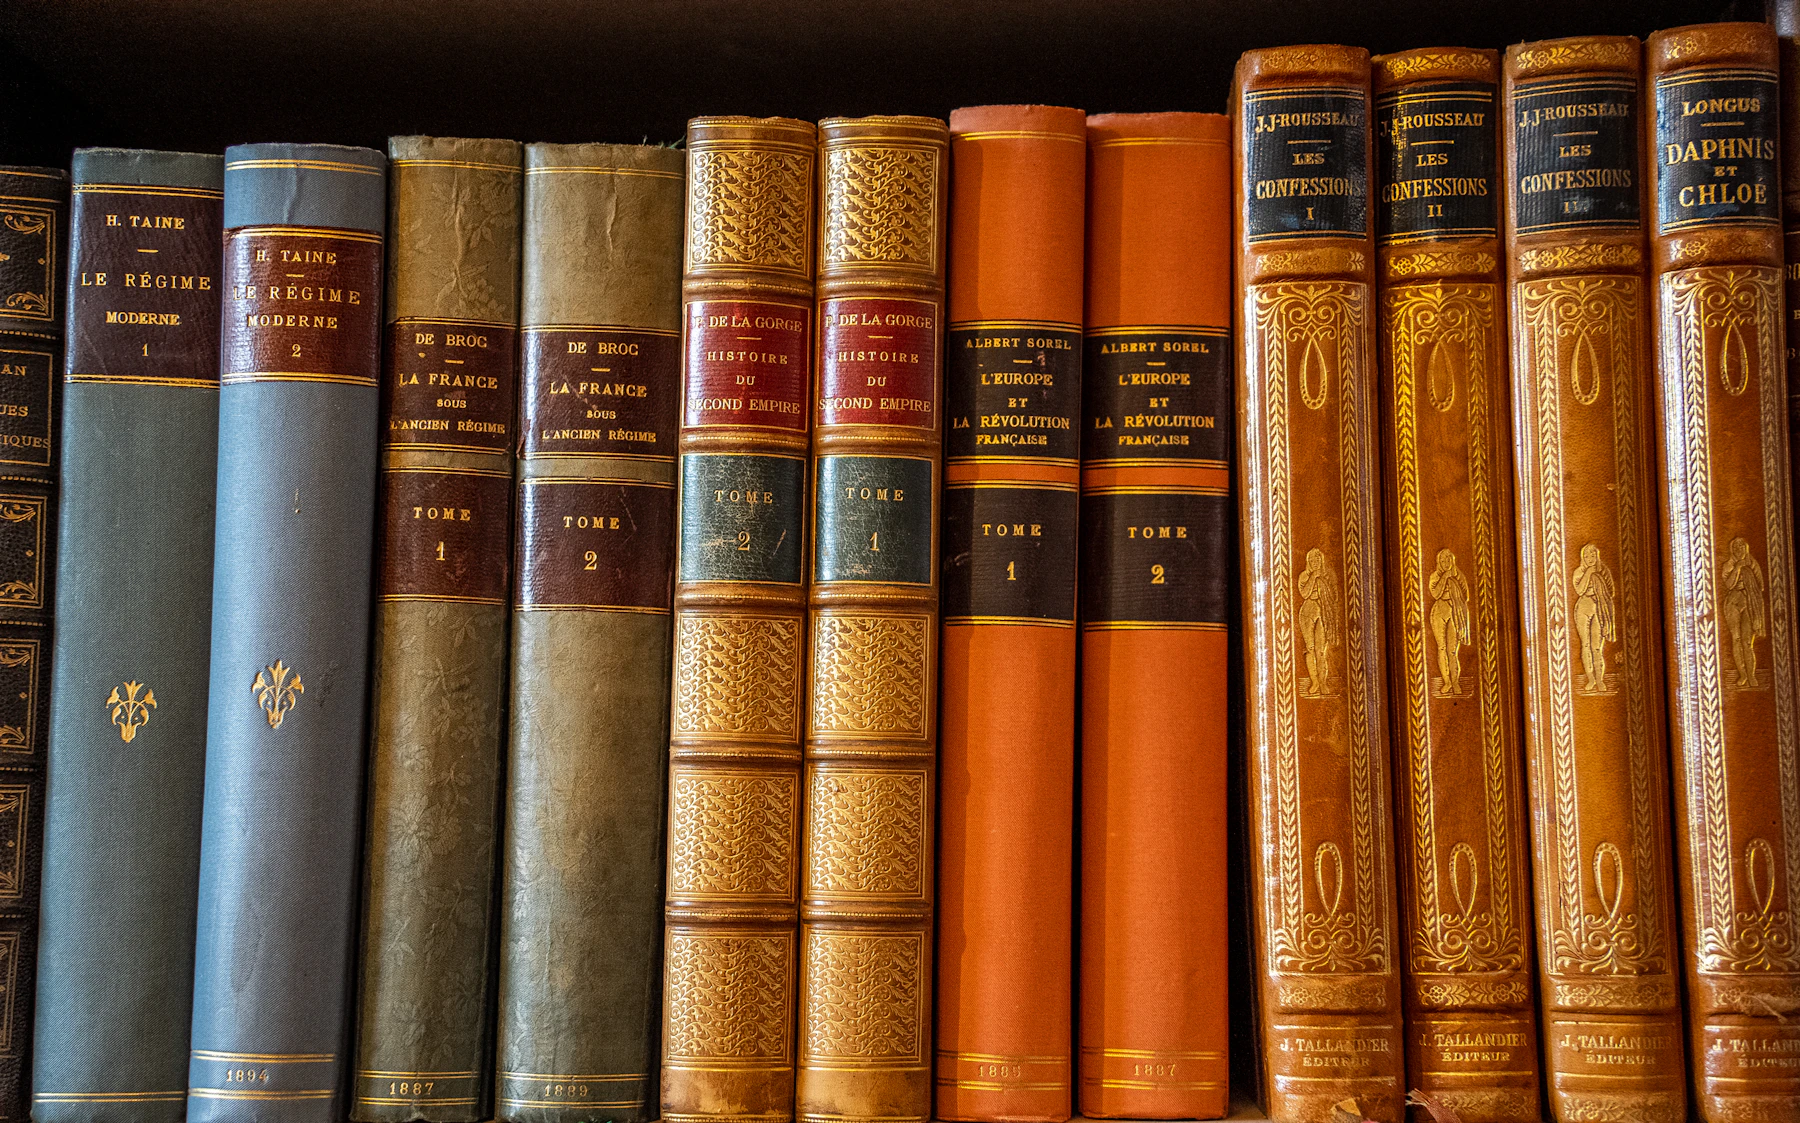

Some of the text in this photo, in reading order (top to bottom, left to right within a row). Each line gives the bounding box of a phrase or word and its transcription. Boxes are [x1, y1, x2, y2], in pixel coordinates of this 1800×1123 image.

[1681, 98, 1761, 117] LONGUS
[1559, 144, 1592, 158] LES
[1666, 138, 1775, 166] DAPHNIS
[1292, 153, 1325, 166] LES
[1416, 153, 1449, 167] LES
[1714, 166, 1737, 177] ET
[1521, 169, 1632, 194] CONFESSIONS
[1382, 178, 1488, 203] CONFESSIONS
[1678, 178, 1767, 207] CHLOÉ
[1306, 207, 1314, 221] I
[1427, 204, 1443, 218] II
[106, 214, 185, 230] H. TAINE
[255, 249, 337, 265] H. TAINE
[81, 271, 211, 290] LE RÉGIME
[233, 282, 361, 305] LE RÉGIME
[106, 311, 181, 326] MODERNE
[247, 314, 338, 329] MODERNE
[709, 315, 728, 328] DE
[731, 315, 752, 328] LA
[839, 314, 858, 327] DE
[861, 313, 882, 326] LA
[415, 333, 487, 348] DE BROC
[966, 338, 1072, 350] ALBERT SOREL
[141, 343, 149, 357] 1
[291, 344, 301, 358] 2
[567, 342, 639, 356] DE BROC
[1101, 342, 1210, 354] ALBERT SOREL
[707, 351, 788, 365] HISTOIRE
[838, 351, 919, 364] HISTOIRE
[399, 373, 498, 389] LA FRANCE
[736, 375, 756, 386] DU
[867, 376, 887, 387] DU
[981, 373, 1053, 386] L'EUROPE
[1119, 373, 1191, 386] L'EUROPE
[550, 382, 648, 398] LA FRANCE
[436, 399, 467, 409] SOUS
[749, 399, 801, 415] EMPIRE
[819, 397, 932, 413] SECOND EMPIRE
[1008, 397, 1028, 408] ET
[1149, 397, 1169, 408] ET
[586, 410, 616, 419] SOUS
[953, 413, 1071, 429] LA RÉVOLUTION
[1095, 413, 1215, 429] LA RÉVOLUTION
[390, 419, 506, 434] L'ANCIEN RÉGIME
[608, 428, 657, 443] RÉGIME
[976, 434, 1048, 447] FRANÇAISE
[1118, 434, 1190, 447] FRANÇAISE
[714, 490, 773, 504] TOME
[846, 487, 903, 501] TOME
[413, 507, 471, 521] TOME
[563, 516, 620, 529] TOME
[982, 524, 1042, 537] TOME
[1127, 526, 1187, 539] TOME
[737, 532, 751, 551] 2
[869, 532, 880, 551] 1
[435, 541, 446, 561] 1
[584, 550, 598, 571] 2
[1007, 561, 1017, 581] 1
[1151, 564, 1165, 584] 2
[1281, 1038, 1294, 1052] J.
[1434, 1033, 1528, 1047] TALLANDIER
[1560, 1034, 1575, 1048] J.
[1712, 1038, 1729, 1052] J.
[1441, 1048, 1511, 1062] ÉDITEUR
[1586, 1050, 1656, 1065] ÉDITEUR
[226, 1069, 268, 1083] 1894
[1133, 1063, 1177, 1077] 1887
[389, 1082, 435, 1096] 1887
[544, 1084, 589, 1098] 1889
